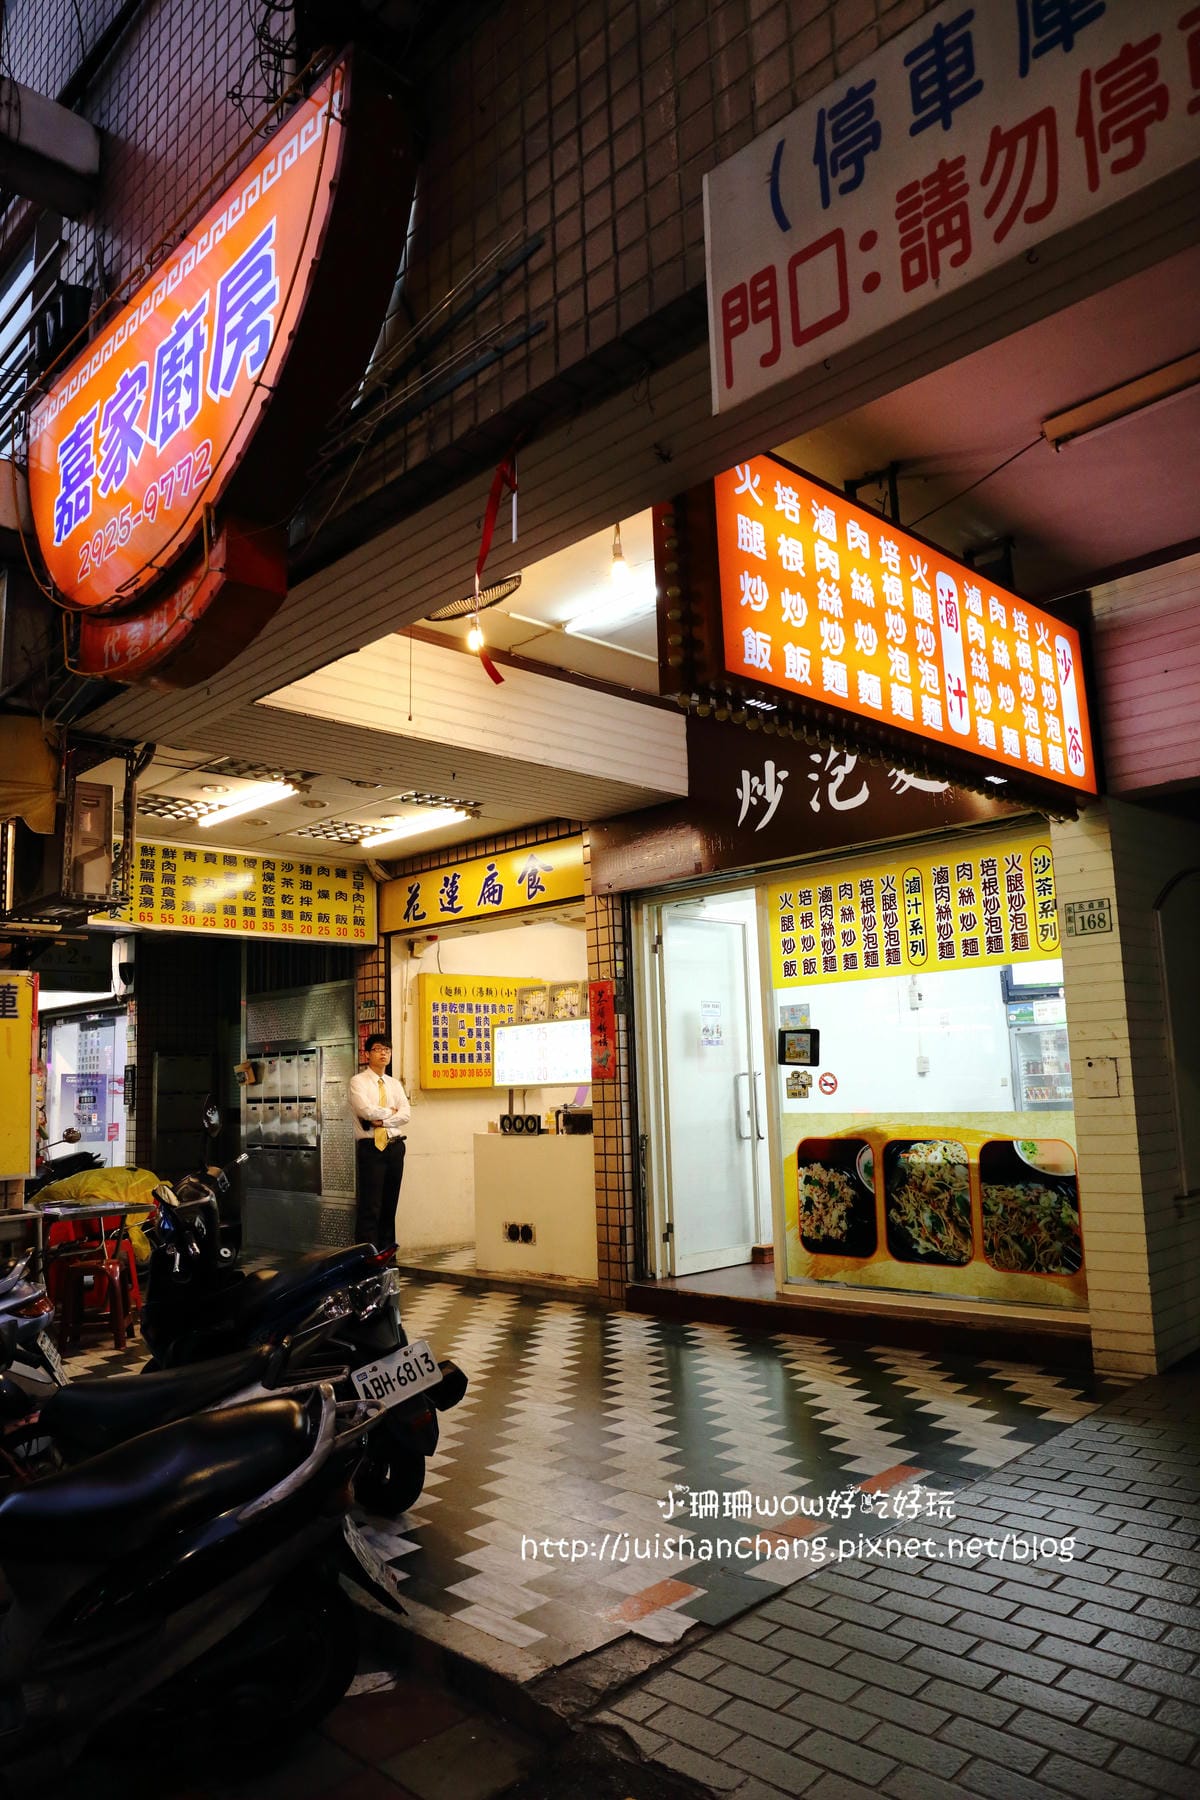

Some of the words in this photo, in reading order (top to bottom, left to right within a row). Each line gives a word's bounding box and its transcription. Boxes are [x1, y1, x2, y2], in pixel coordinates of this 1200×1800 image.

[52, 217, 279, 546] 嘉家廚房
[77, 439, 212, 582] 2925-9772
[734, 464, 772, 672] 火腿炒飯
[811, 498, 849, 698] 滷肉絲炒麵
[846, 519, 883, 711] 肉絲炒麵
[909, 554, 943, 731] 火腿炒泡麵
[939, 587, 967, 720] 滷汁
[963, 580, 997, 751] 滷肉絲炒麵
[988, 595, 1020, 759] 肉絲炒麵
[1035, 622, 1065, 775] 火腿炒泡麵
[1056, 647, 1083, 765] 沙茶
[737, 745, 950, 831] 炒泡
[140, 912, 153, 922] 65
[161, 914, 174, 924] 55
[182, 915, 195, 925] 30
[203, 917, 216, 927] 25
[224, 919, 236, 928] 30
[243, 920, 255, 930] 30
[263, 922, 275, 932] 35
[281, 923, 294, 933] 35
[301, 925, 312, 934] 20
[318, 926, 330, 936] 25
[337, 927, 348, 937] 30
[352, 870, 365, 926] 古早肉片飯
[403, 854, 553, 923] 花蓮扁食
[817, 886, 837, 974] 滷肉絲炒麵
[838, 882, 858, 971] 肉絲炒麵
[880, 875, 902, 966] 火腿炒泡麵
[905, 876, 926, 957] 滷汁系列
[932, 865, 956, 961] 滷肉絲炒麵
[956, 862, 979, 958] 肉絲炒麵
[1004, 853, 1030, 952] 火腿炒泡麵
[1033, 855, 1057, 942] 沙茶系列
[1079, 912, 1106, 930] 168
[354, 928, 365, 938] 35
[779, 891, 798, 978] 火腿炒飯
[361, 1353, 435, 1400] ABH-6813
